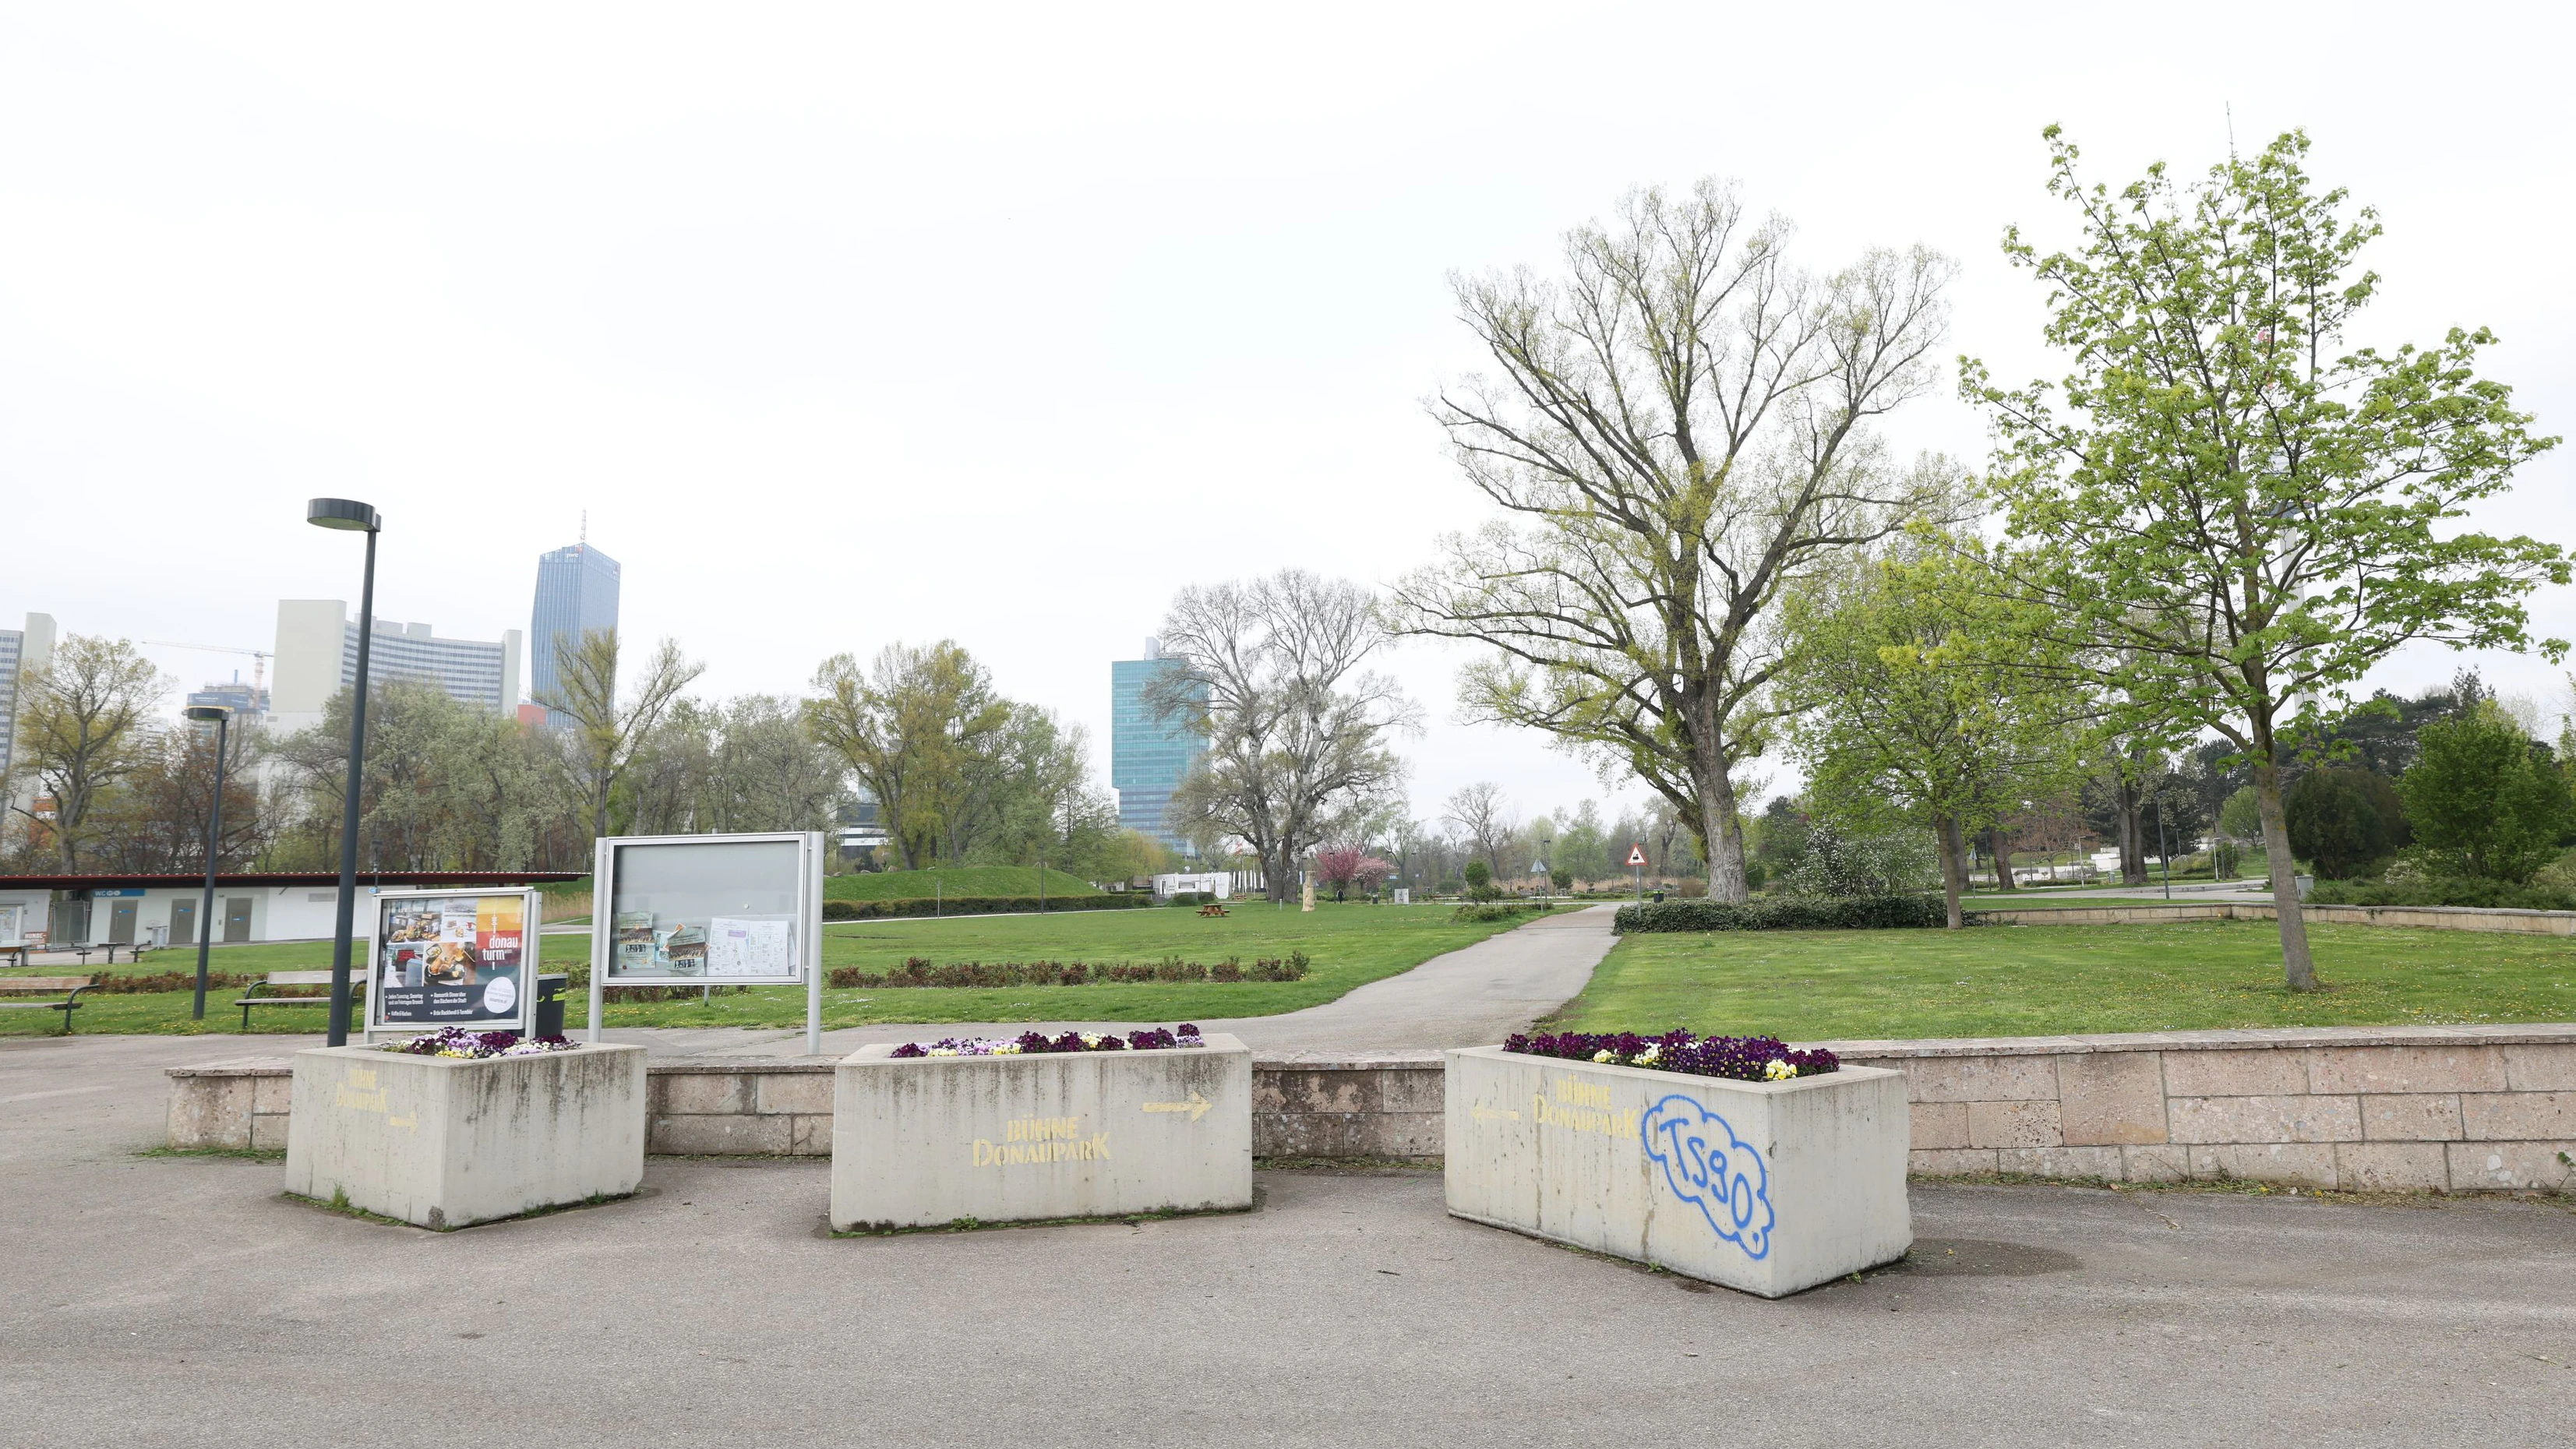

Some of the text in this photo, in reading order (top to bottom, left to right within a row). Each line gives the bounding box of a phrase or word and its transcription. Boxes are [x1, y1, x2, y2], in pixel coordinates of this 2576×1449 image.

[489, 935, 518, 949] donau
[482, 948, 505, 961] turm
[1555, 1073, 1613, 1110] BÜHNE
[1007, 1113, 1080, 1142] BÜHNE
